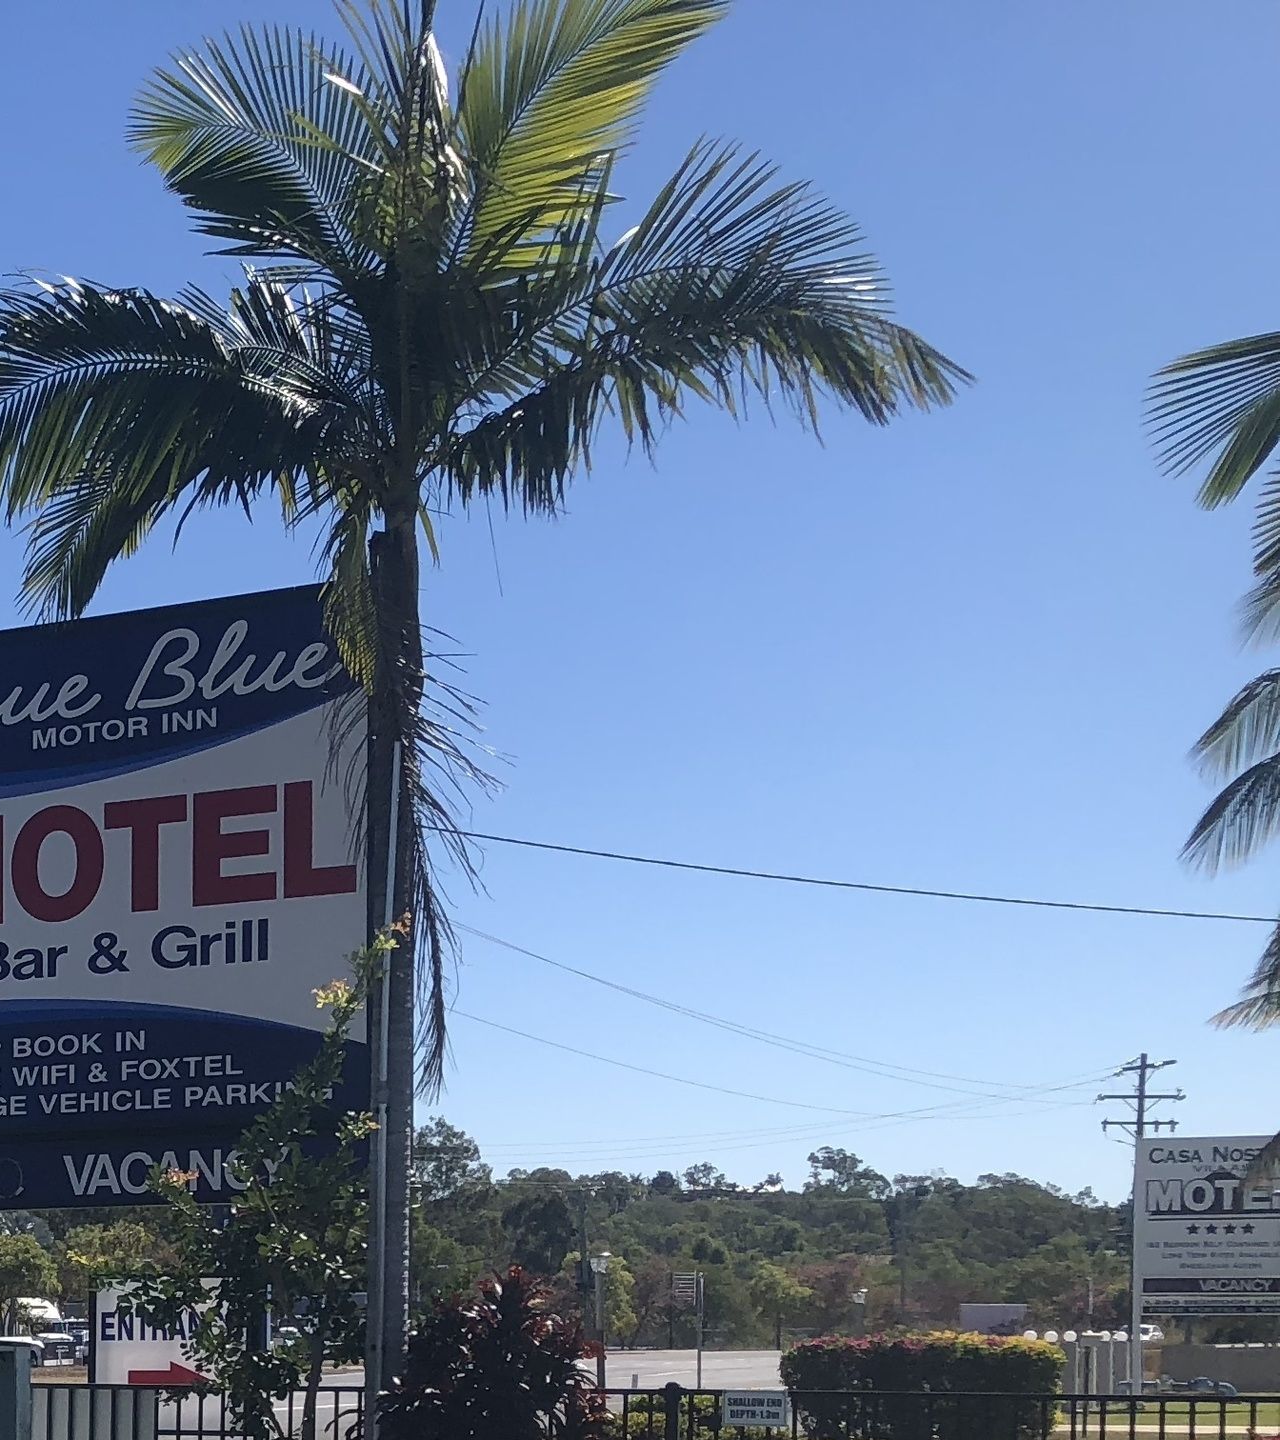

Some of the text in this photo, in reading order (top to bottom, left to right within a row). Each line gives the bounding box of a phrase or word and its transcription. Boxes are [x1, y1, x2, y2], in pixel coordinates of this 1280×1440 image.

[126, 619, 343, 712] Blue
[32, 707, 217, 750] MOTOR INN
[87, 932, 130, 976] &
[151, 918, 269, 968] Grill
[13, 1033, 102, 1059] BOOK
[115, 1030, 146, 1053] IN
[12, 1063, 75, 1088] WIFI
[88, 1062, 108, 1084] &
[121, 1053, 243, 1082] FOXTEL
[39, 1089, 171, 1115] VEHICLE
[1199, 1279, 1273, 1291] VACANCY
[728, 1397, 782, 1407] SHALLOW END
